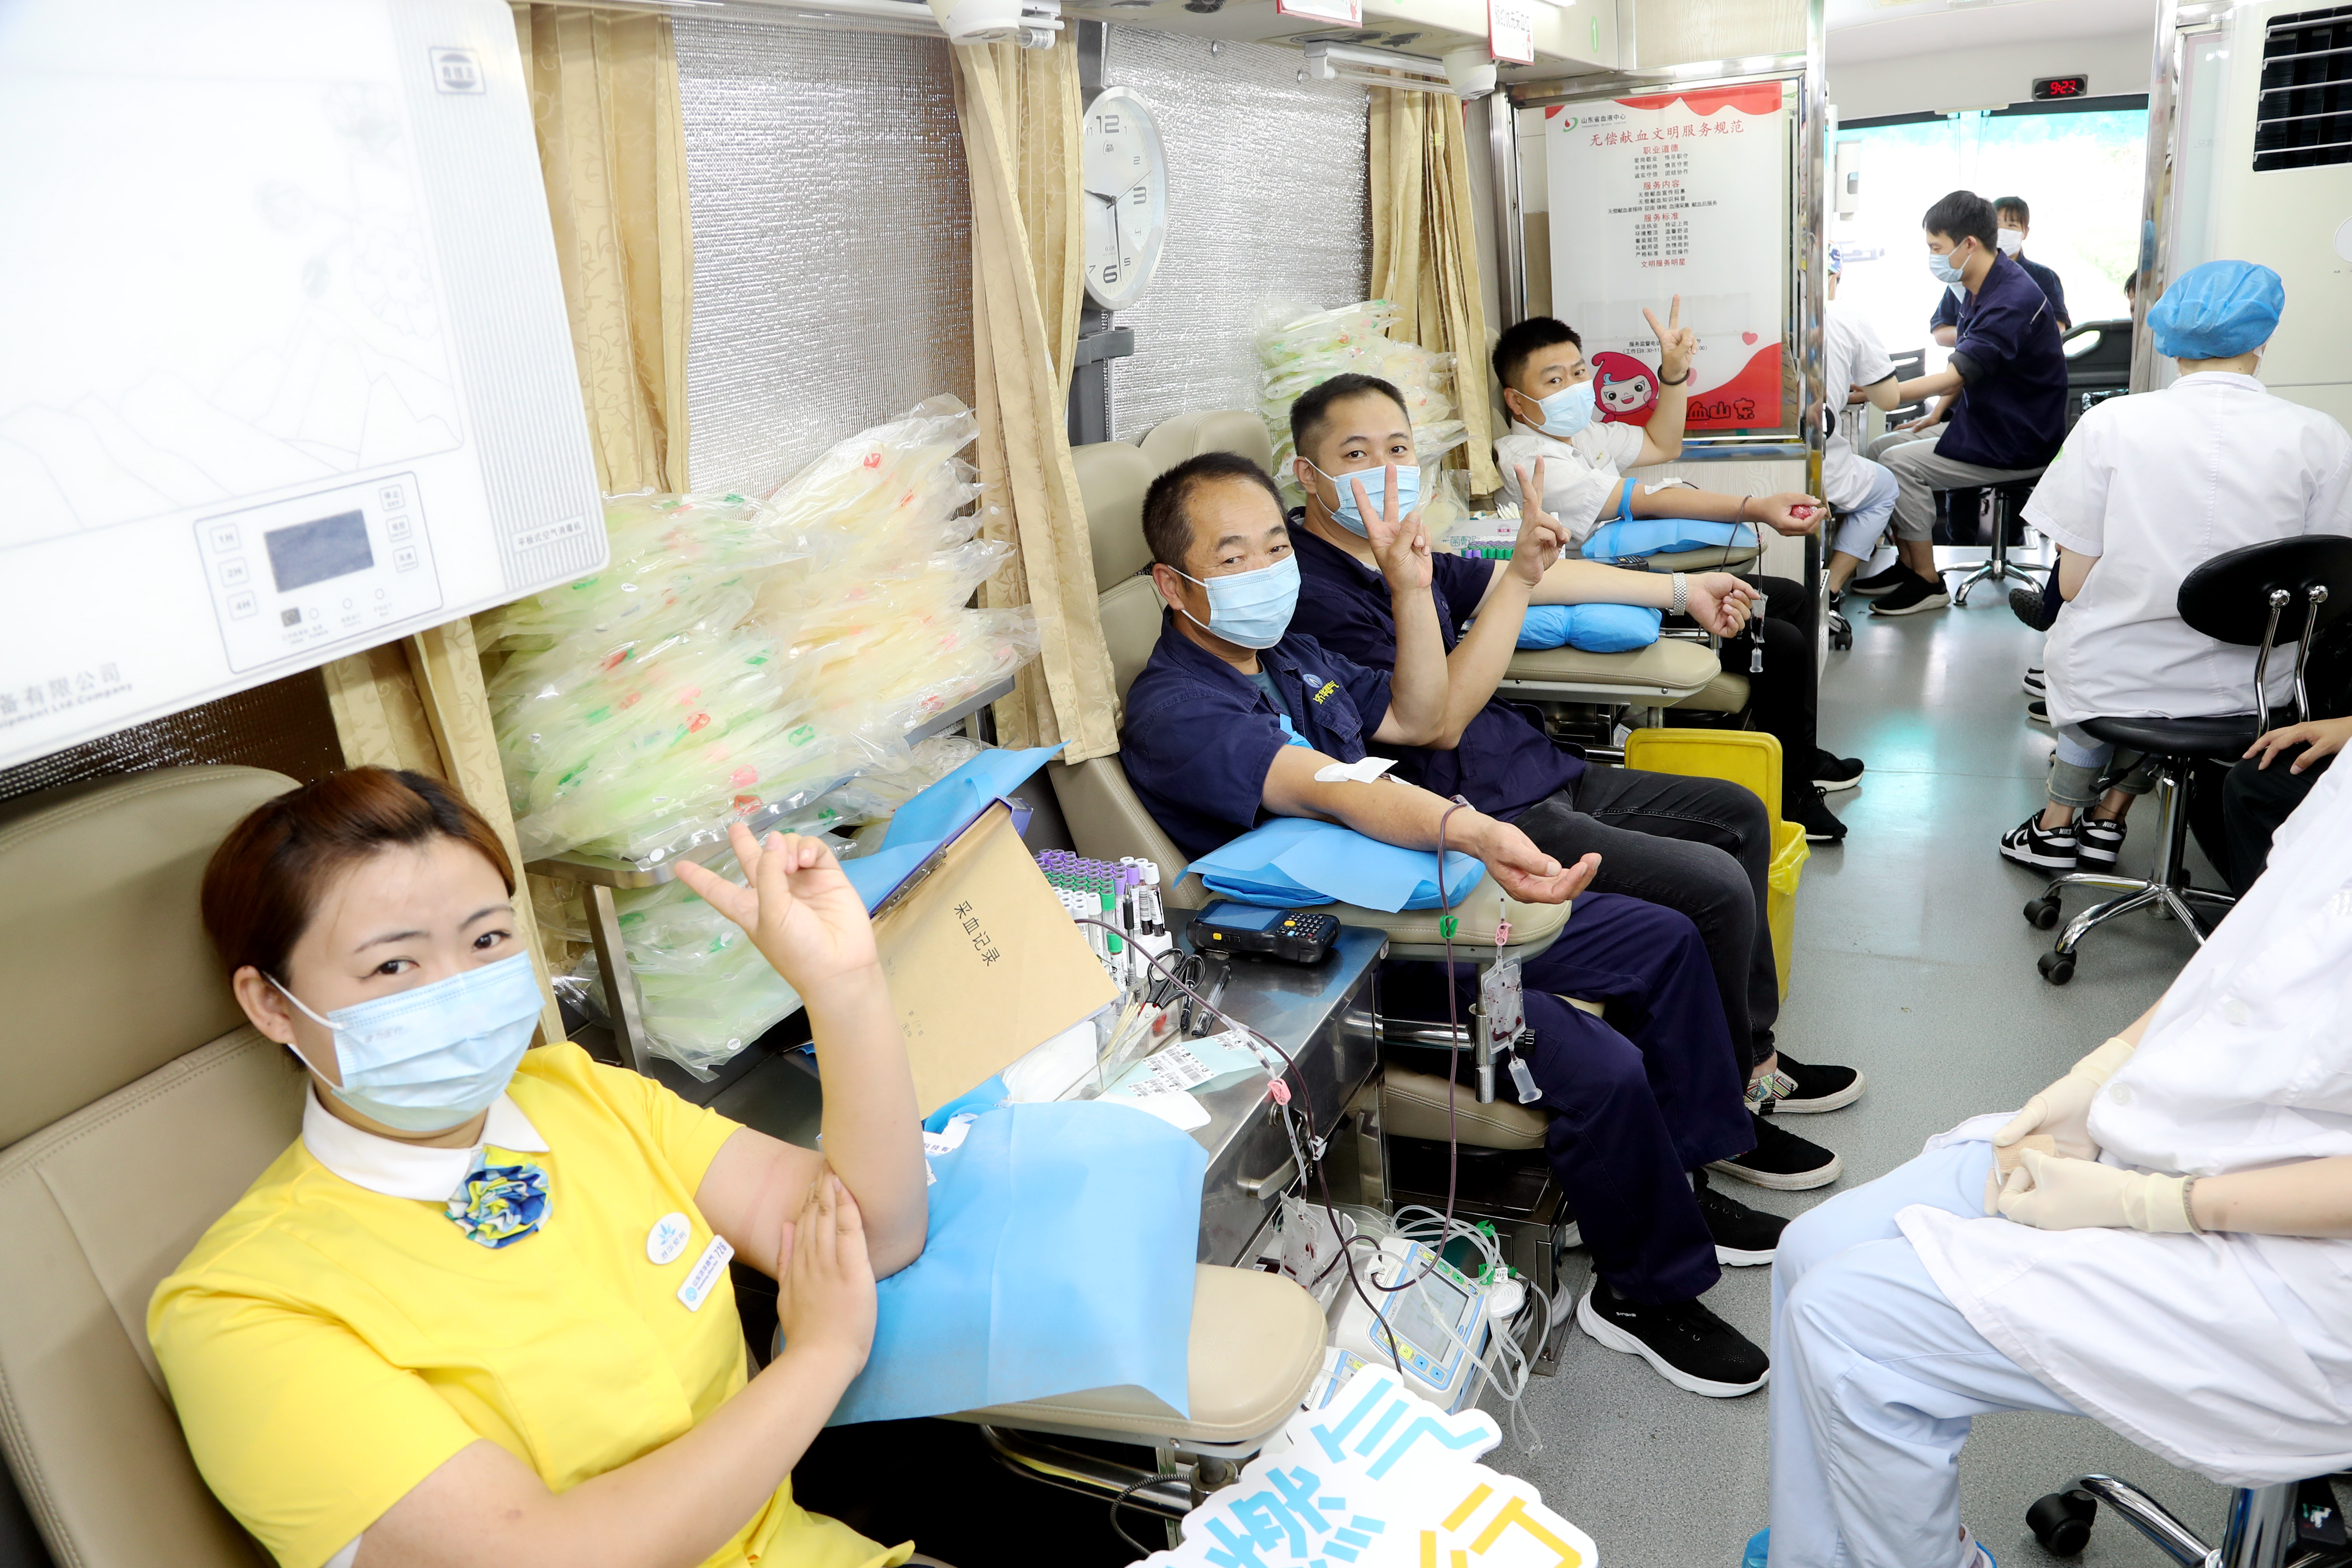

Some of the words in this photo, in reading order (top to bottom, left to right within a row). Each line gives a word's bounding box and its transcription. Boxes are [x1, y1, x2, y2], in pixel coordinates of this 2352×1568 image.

[2050, 80, 2076, 95] 9:23
[1096, 114, 1120, 134] 12
[1581, 113, 1626, 124] 山东省血液中心
[1589, 119, 1744, 147] 无偿献血文明服务规范
[1643, 144, 1679, 155] 职业道德
[1133, 156, 1141, 165] 2
[1643, 179, 1680, 190] 服务内容
[1133, 186, 1147, 205] 3
[1644, 212, 1679, 222] 服务标准
[1134, 227, 1142, 236] 4
[1124, 257, 1131, 267] 5
[1641, 258, 1686, 268] 文明服务明星
[1088, 264, 1096, 275] 7
[1102, 264, 1118, 284] 6
[518, 521, 582, 546] 平板式空气消毒机
[2102, 821, 2117, 830] NIKE
[953, 900, 1003, 968] 采血记录
[713, 1241, 727, 1259] 726
